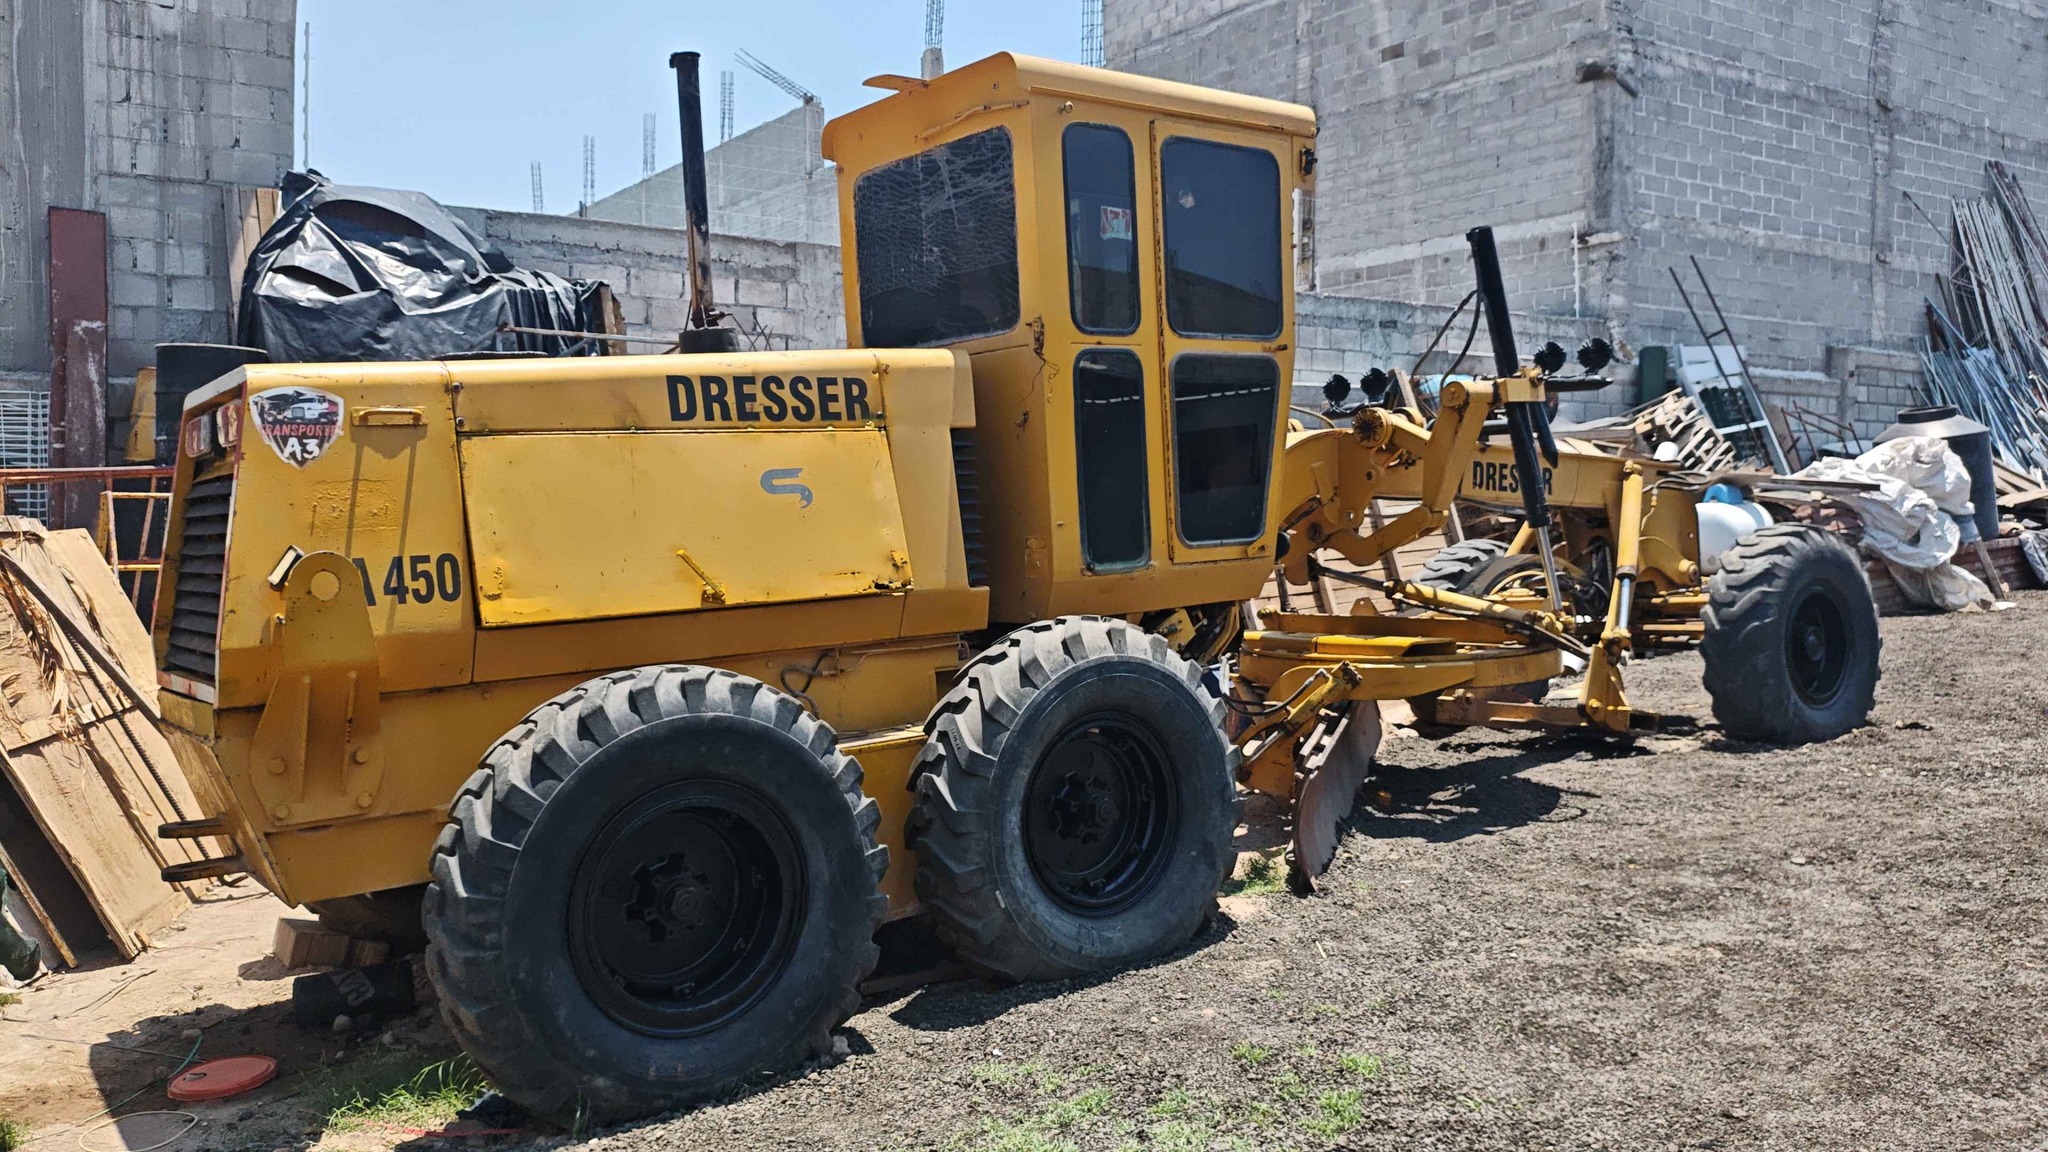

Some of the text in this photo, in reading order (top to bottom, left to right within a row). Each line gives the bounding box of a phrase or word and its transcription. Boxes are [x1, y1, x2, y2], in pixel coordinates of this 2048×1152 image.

[666, 375, 871, 422] DRESSER
[283, 437, 320, 461] A3
[1472, 461, 1553, 495] DRESR
